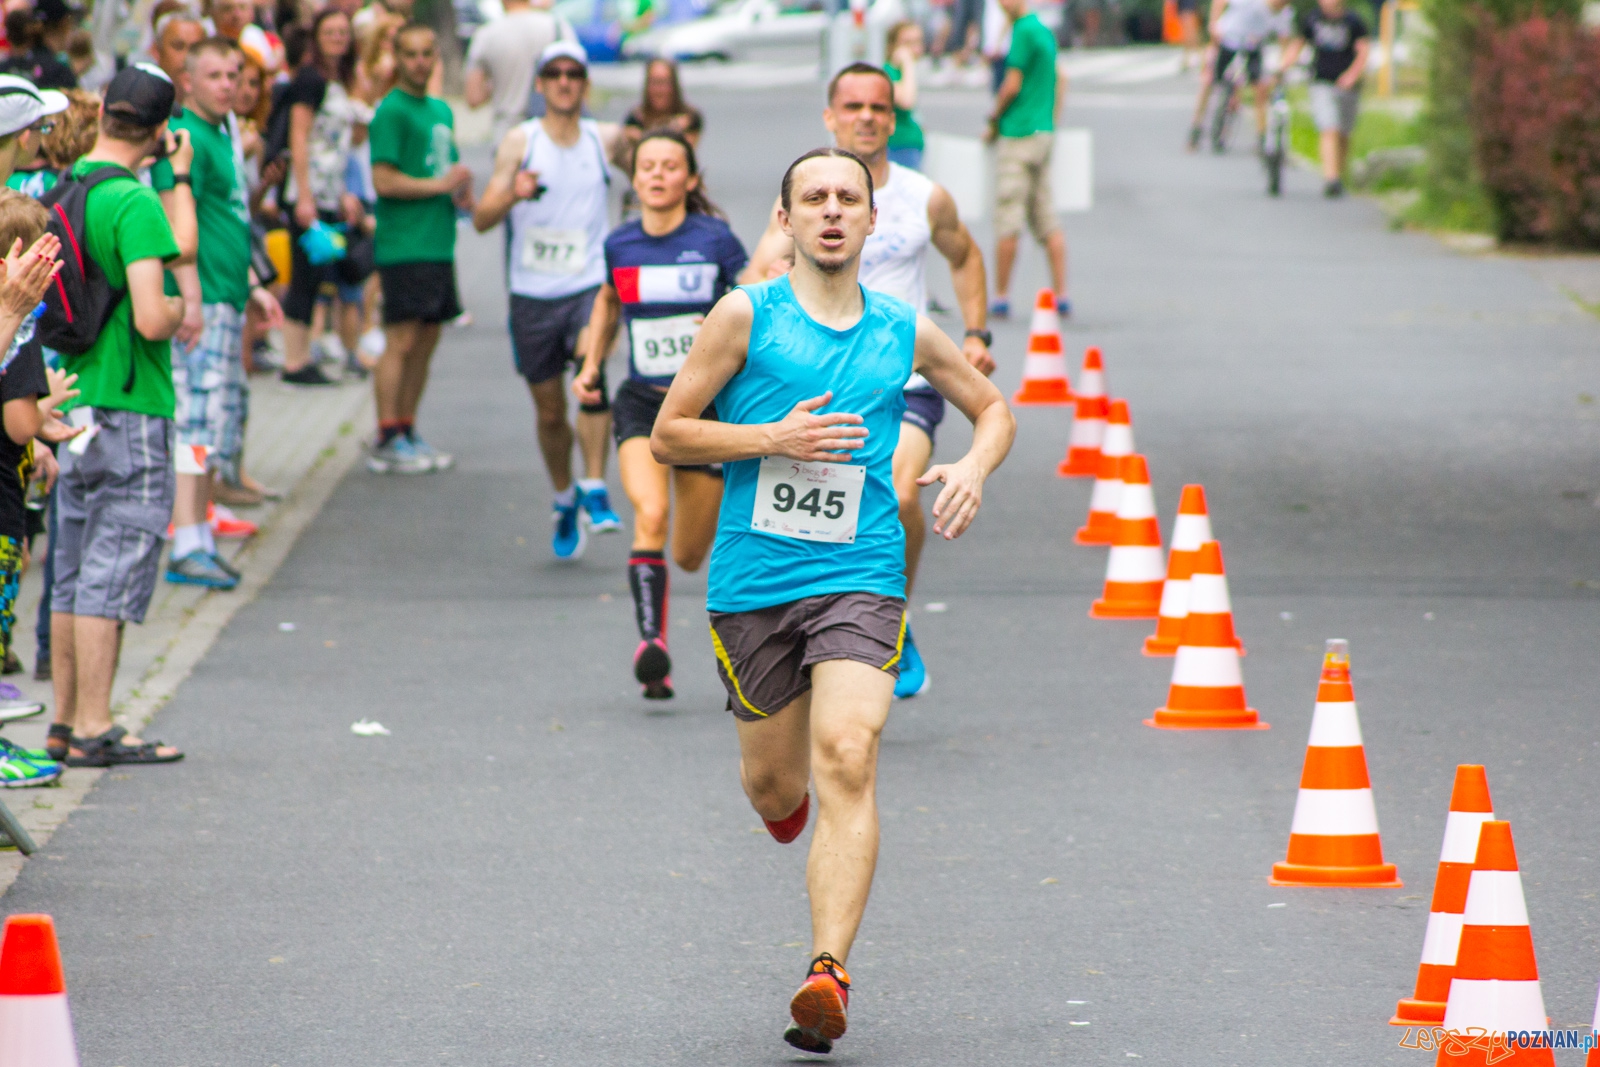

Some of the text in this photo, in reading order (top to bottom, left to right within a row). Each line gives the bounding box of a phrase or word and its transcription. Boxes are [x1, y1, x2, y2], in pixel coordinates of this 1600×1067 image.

[533, 241, 575, 261] 977
[644, 335, 693, 358] 938
[772, 483, 846, 519] 945
